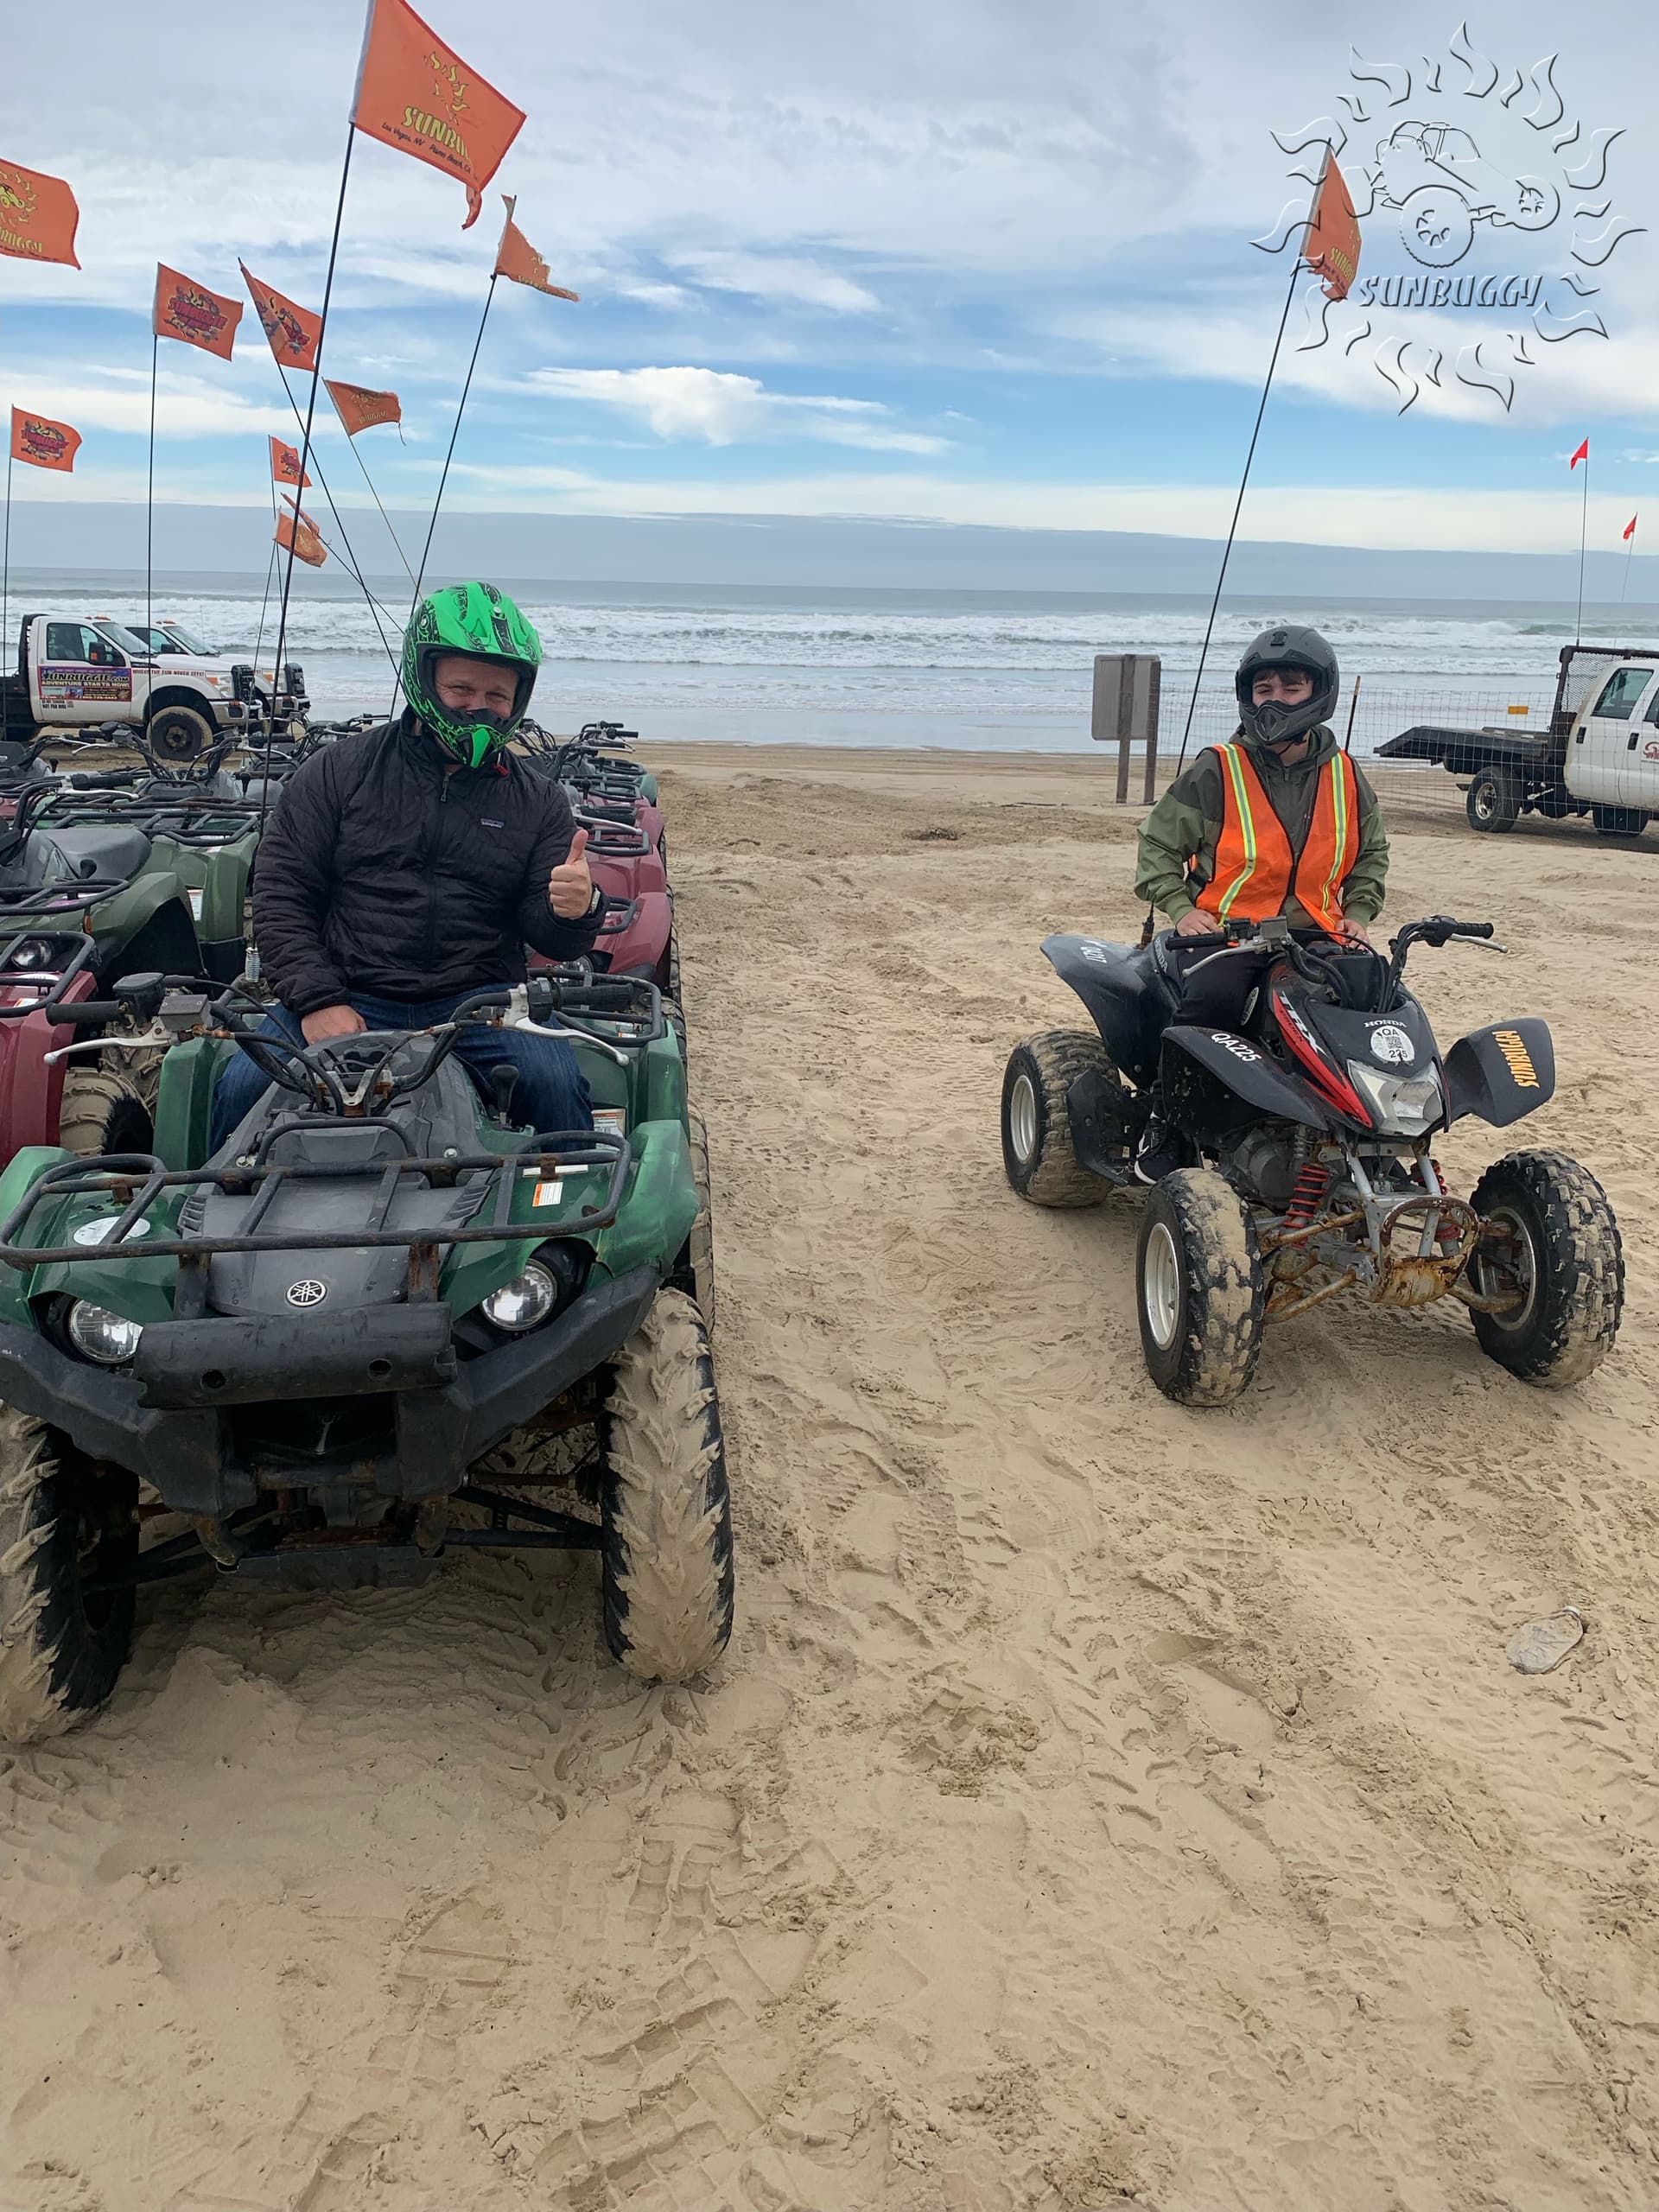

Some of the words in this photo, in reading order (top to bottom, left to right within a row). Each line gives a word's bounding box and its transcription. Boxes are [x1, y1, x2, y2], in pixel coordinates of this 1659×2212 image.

[1279, 990, 1331, 1059] TRX
[1363, 1019, 1408, 1028] HONDA
[1211, 1033, 1262, 1062] QA225
[1389, 1049, 1408, 1058] 225
[1491, 1030, 1541, 1089] SUNBUGGY
